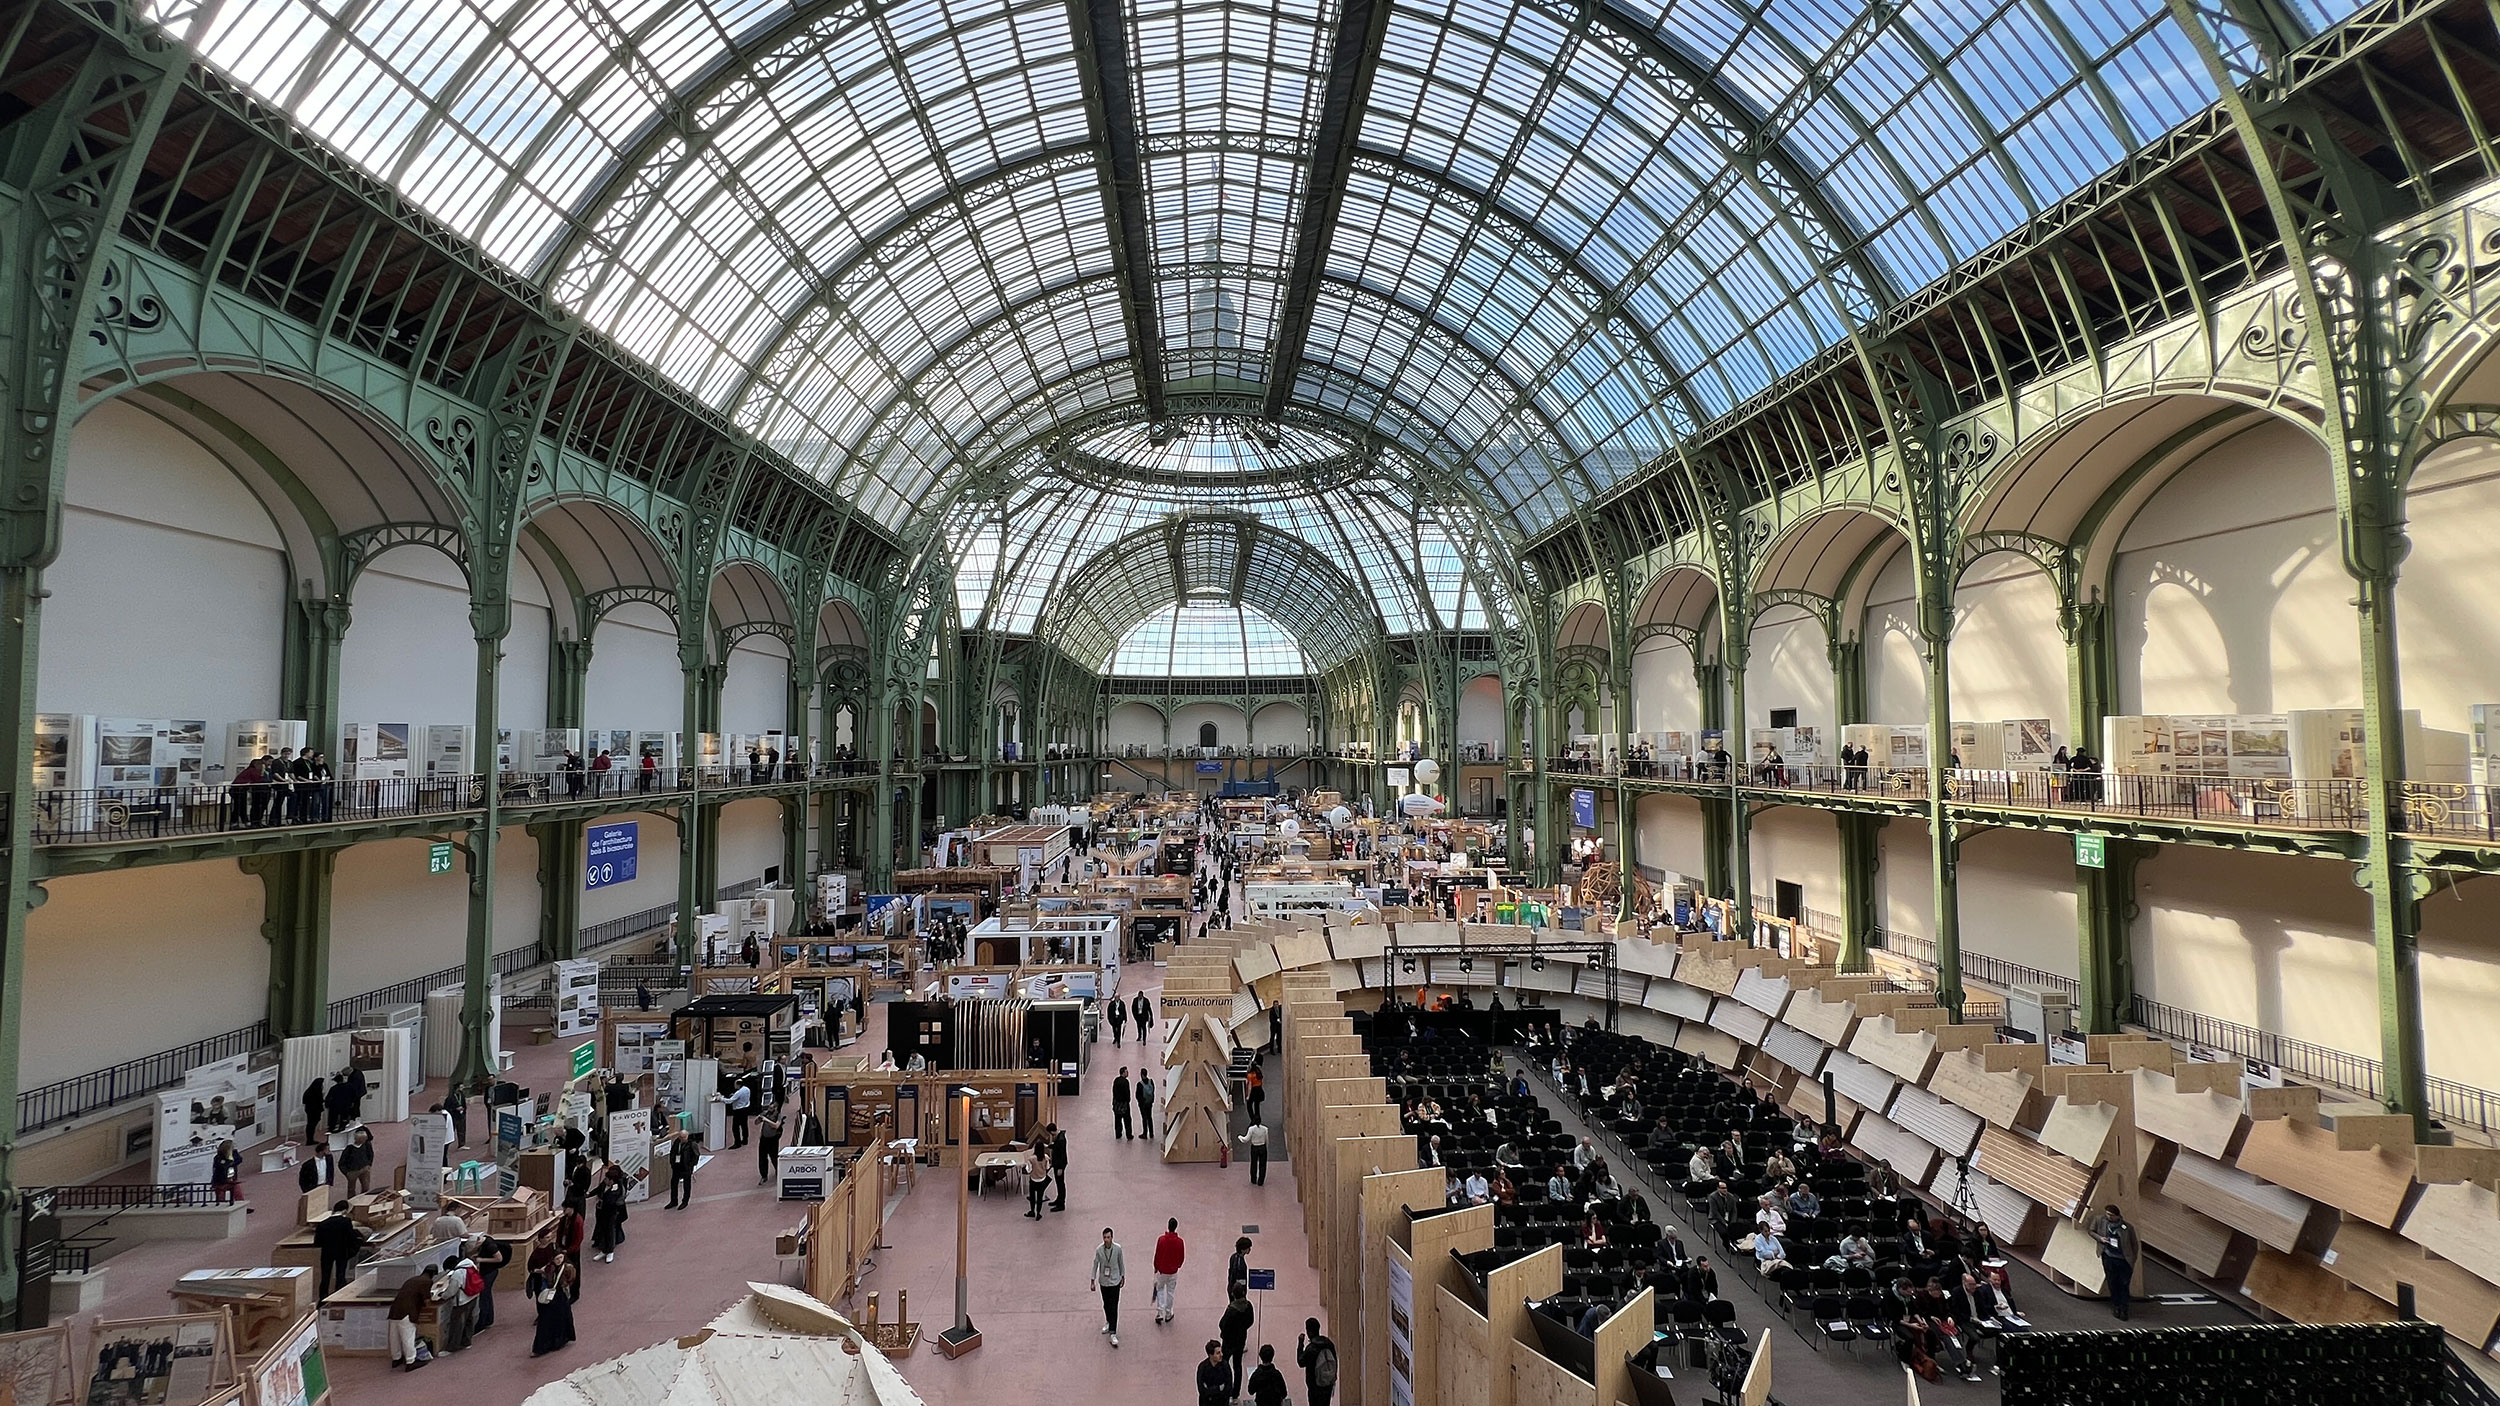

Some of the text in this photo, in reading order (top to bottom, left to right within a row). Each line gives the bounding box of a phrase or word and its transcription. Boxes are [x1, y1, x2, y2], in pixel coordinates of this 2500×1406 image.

[604, 830, 622, 839] Galerie
[600, 836, 632, 846] l'architecture
[1160, 996, 1233, 1007] Pan'Auditorium
[788, 1166, 817, 1174] ARBOR
